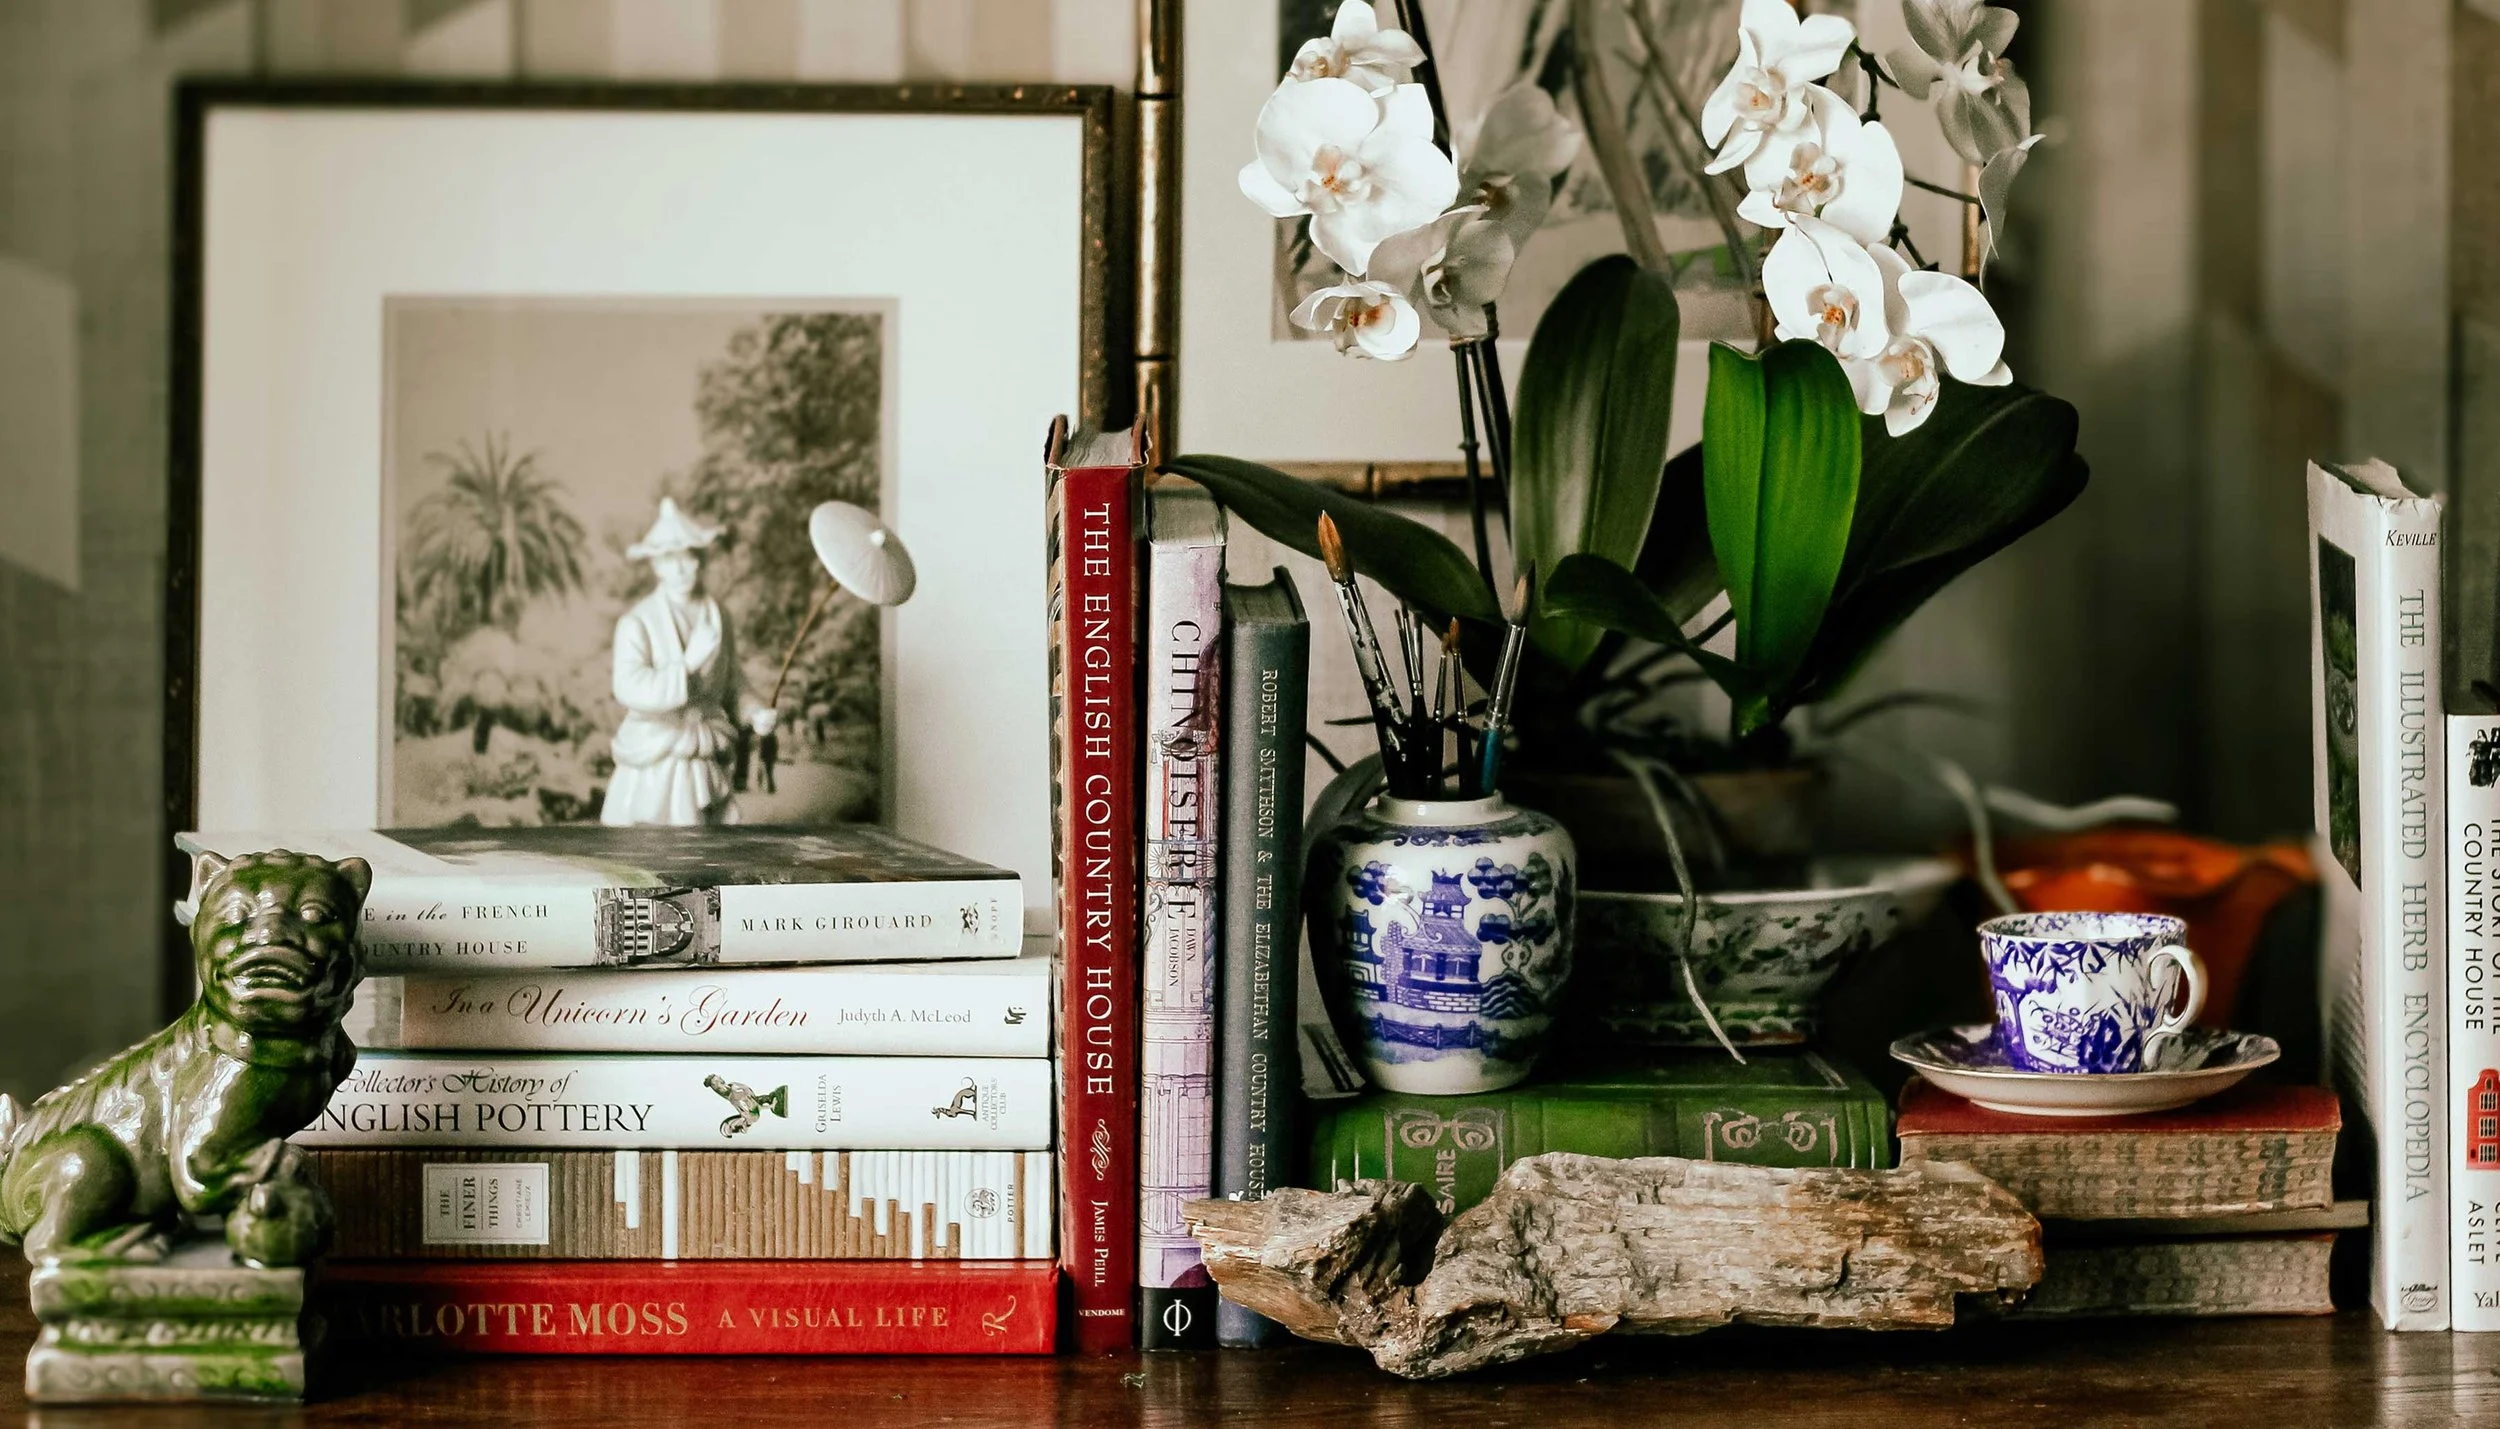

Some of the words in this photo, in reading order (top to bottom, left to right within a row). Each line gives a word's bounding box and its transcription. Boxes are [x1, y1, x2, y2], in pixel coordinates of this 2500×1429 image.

[1083, 502, 1112, 577] THE
[2385, 529, 2437, 547] KEVILLE
[2399, 588, 2425, 648] THE
[1083, 592, 1112, 759] ENGLISH
[1260, 669, 1279, 737] ROBERT
[1166, 619, 1202, 919] CHINOISERIE
[2399, 669, 2428, 860] ILLUSTRATED
[1257, 748, 1276, 839] SMYTHSON
[1084, 774, 1112, 952] COUNTRY
[1256, 849, 1273, 863] &
[2464, 822, 2483, 938] COUNTRY
[386, 909, 408, 921] in
[416, 901, 448, 921] the
[461, 903, 549, 919] FRENCH
[1255, 874, 1273, 911] THE
[456, 940, 528, 955] HOUSE
[741, 917, 804, 932] MARK
[815, 914, 933, 931] GIROUARD
[1186, 927, 1197, 962] DAWN
[2402, 880, 2429, 972] HERB
[1168, 927, 1181, 987] JACOBSON
[1252, 922, 1271, 1040] ELIZABETHAN
[431, 987, 475, 1015] In
[506, 984, 673, 1026] Unicorn's
[679, 984, 810, 1037] Garden
[2465, 947, 2485, 1031] HOUSE
[836, 1007, 887, 1026] Judyth
[890, 1008, 907, 1023] A.
[910, 1008, 972, 1024] McLeod
[1085, 966, 1114, 1095] HOUSE
[442, 1066, 545, 1102] History
[549, 1069, 579, 1102] of
[815, 1073, 827, 1134] GRISELDA
[830, 1084, 842, 1123] LEWIS
[1250, 1053, 1268, 1133] COUNTRY
[2403, 992, 2431, 1203] ENCYCLOPEDIA
[302, 1102, 462, 1133] NGLISH
[474, 1102, 655, 1133] POTTERY
[439, 1189, 451, 1218] THE
[463, 1176, 477, 1231] FINER
[488, 1178, 499, 1229] THINGS
[1007, 1183, 1015, 1223] POTTER
[1090, 1199, 1109, 1242] JAMES
[2467, 1200, 2485, 1265] ASLET
[1094, 1248, 1109, 1288] PEILL
[567, 1301, 689, 1336] MOSS
[717, 1308, 737, 1329] A
[748, 1307, 863, 1328] VISUAL
[875, 1307, 949, 1328] LIFE
[1078, 1308, 1126, 1318] VENDOME
